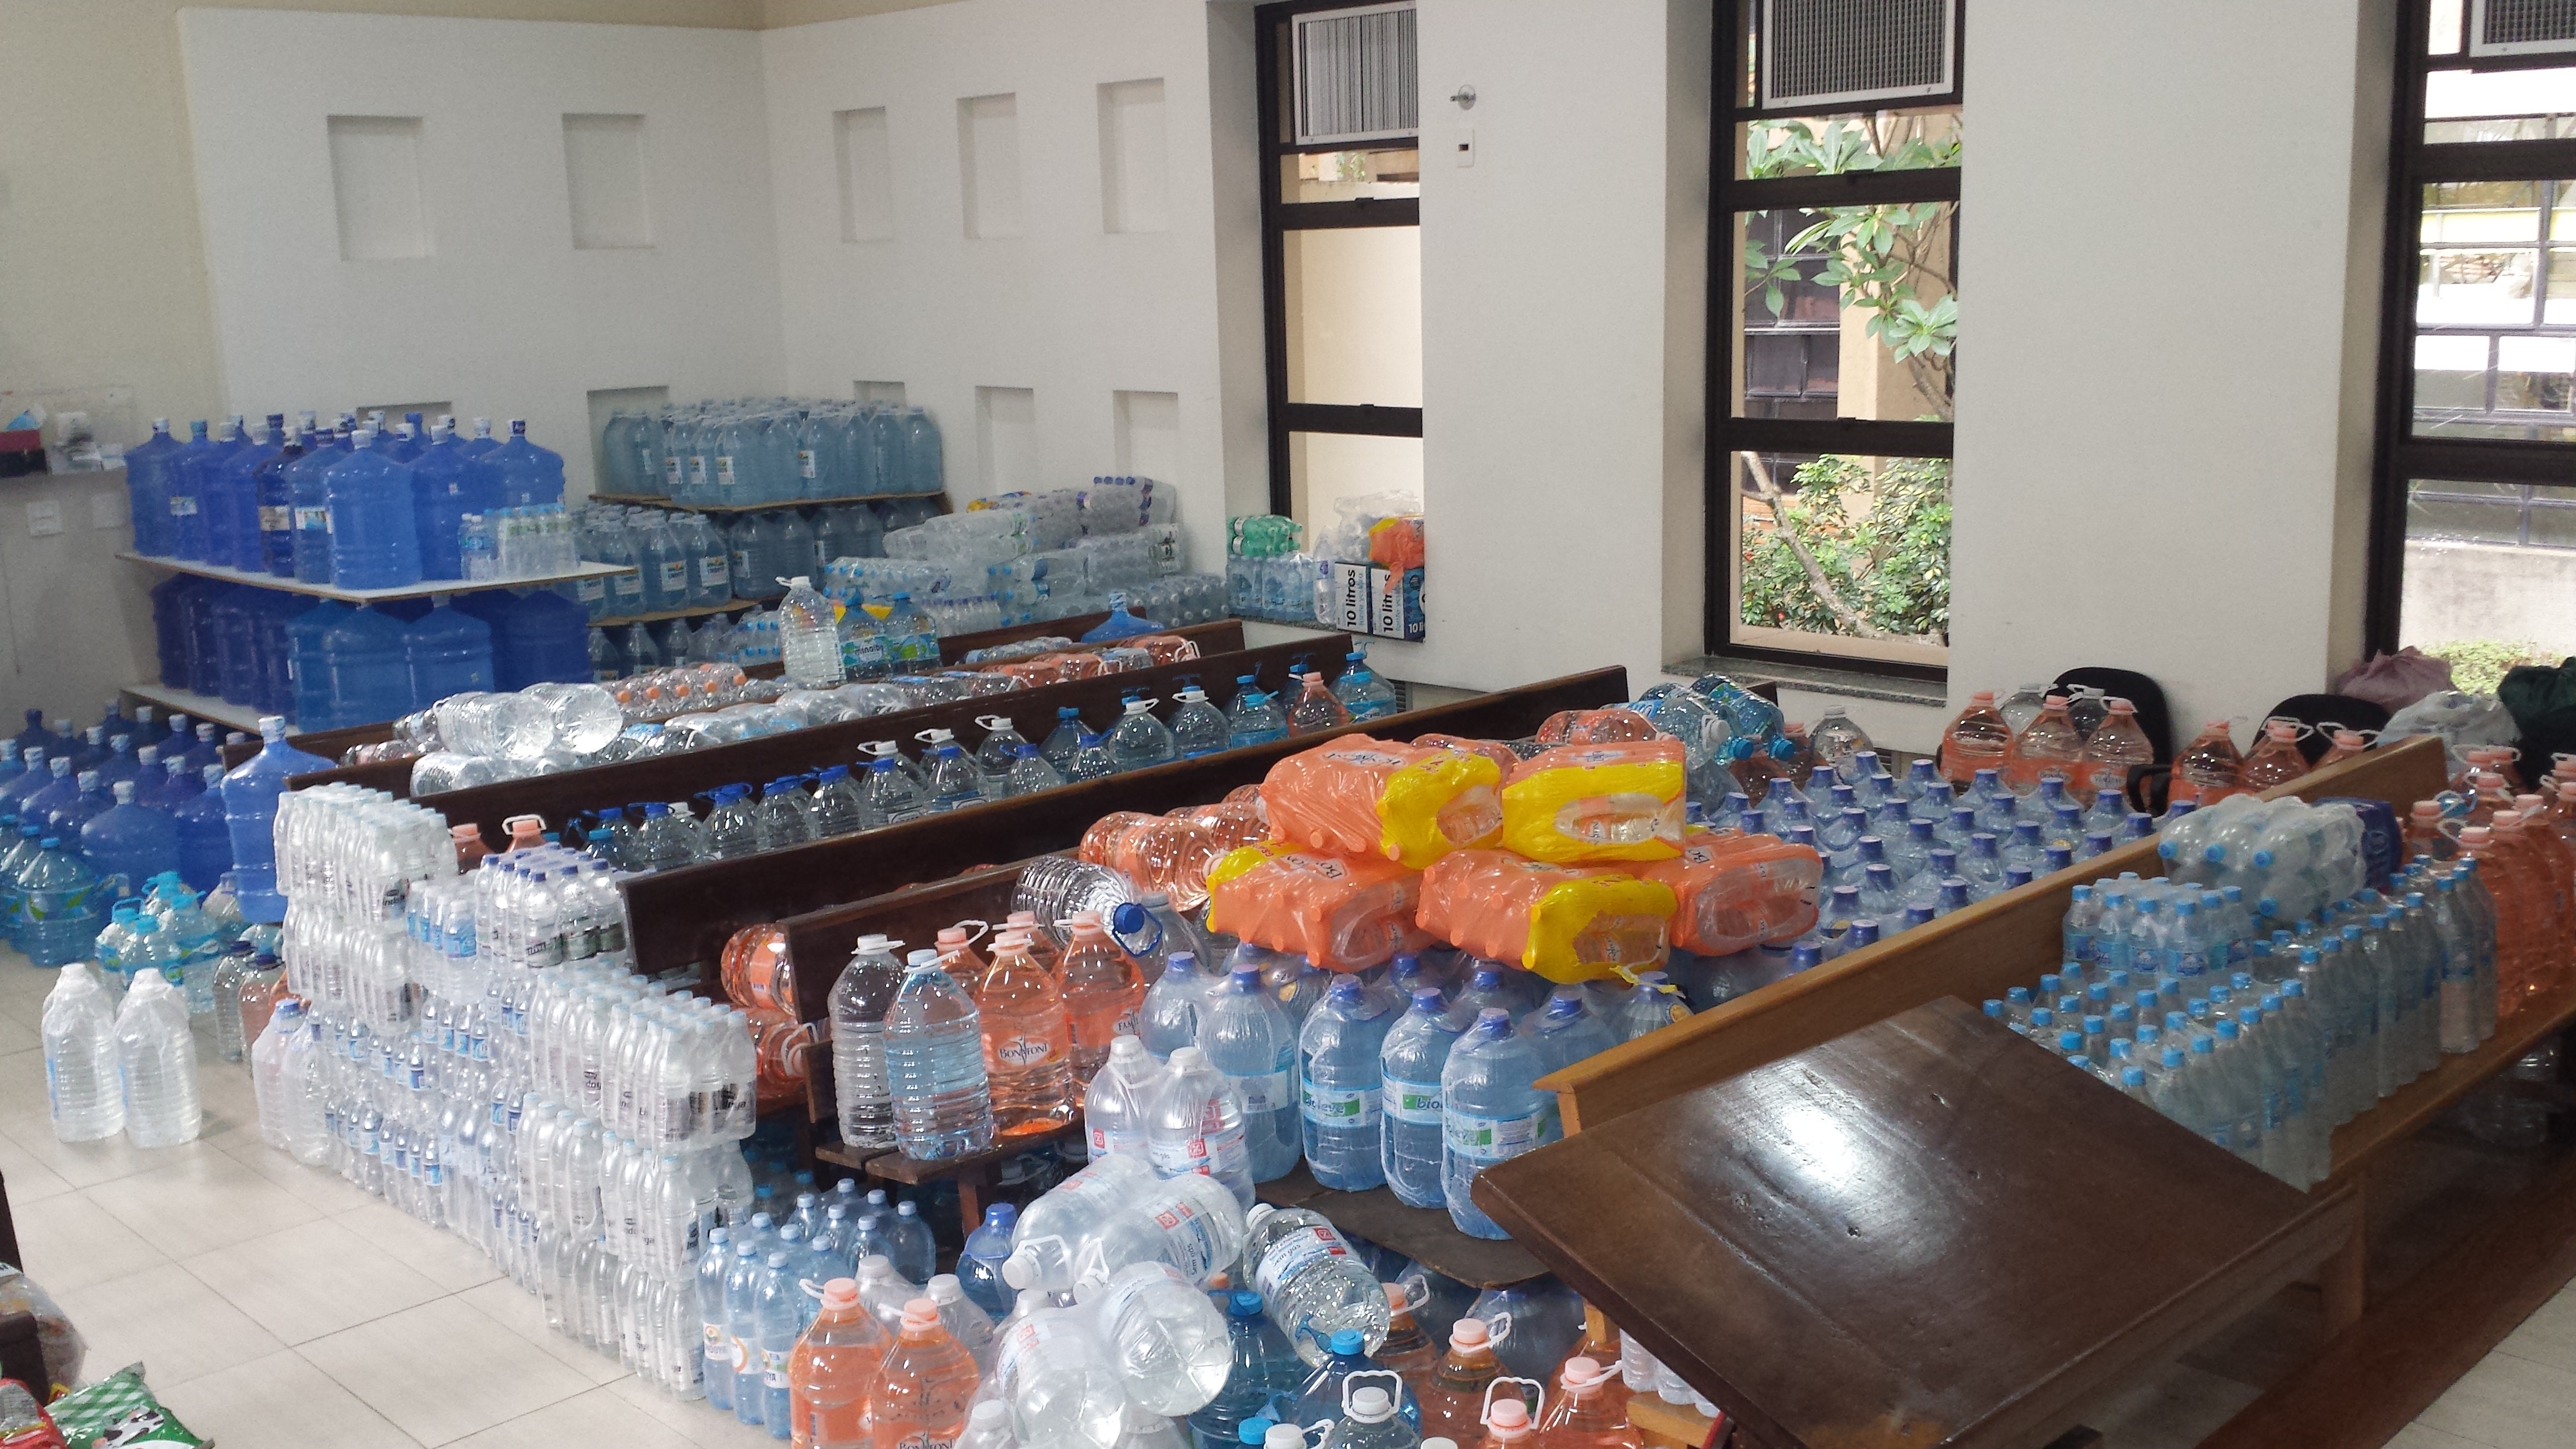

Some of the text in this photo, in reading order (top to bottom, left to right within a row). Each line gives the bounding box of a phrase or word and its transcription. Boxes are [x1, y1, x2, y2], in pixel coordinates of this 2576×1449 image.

[1345, 569, 1357, 627] 10 litros
[1382, 574, 1393, 632] 10 litrs
[1409, 624, 1418, 633] 10
